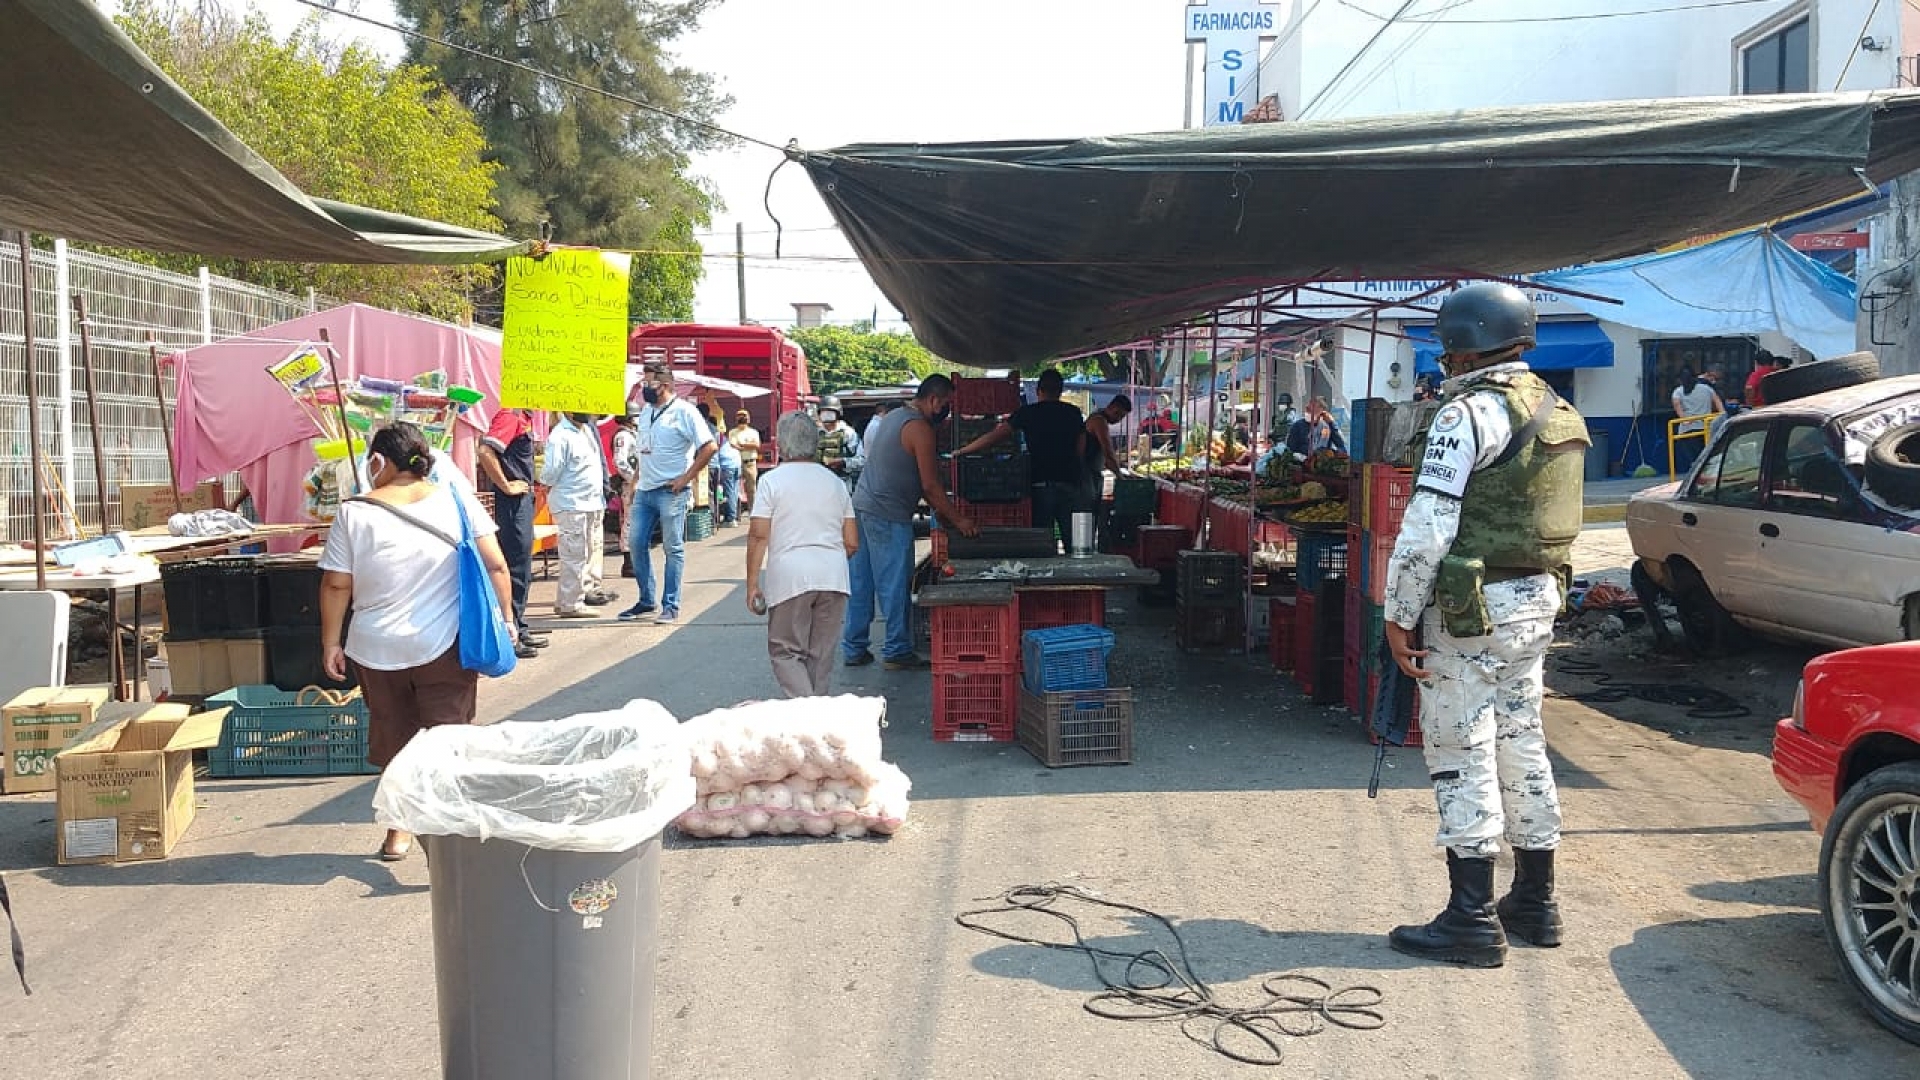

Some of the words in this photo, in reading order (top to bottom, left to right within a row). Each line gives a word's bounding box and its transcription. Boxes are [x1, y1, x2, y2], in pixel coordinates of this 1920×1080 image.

[1193, 11, 1273, 31] FARMACIAS
[602, 262, 617, 280] la
[1426, 447, 1446, 460] GN
